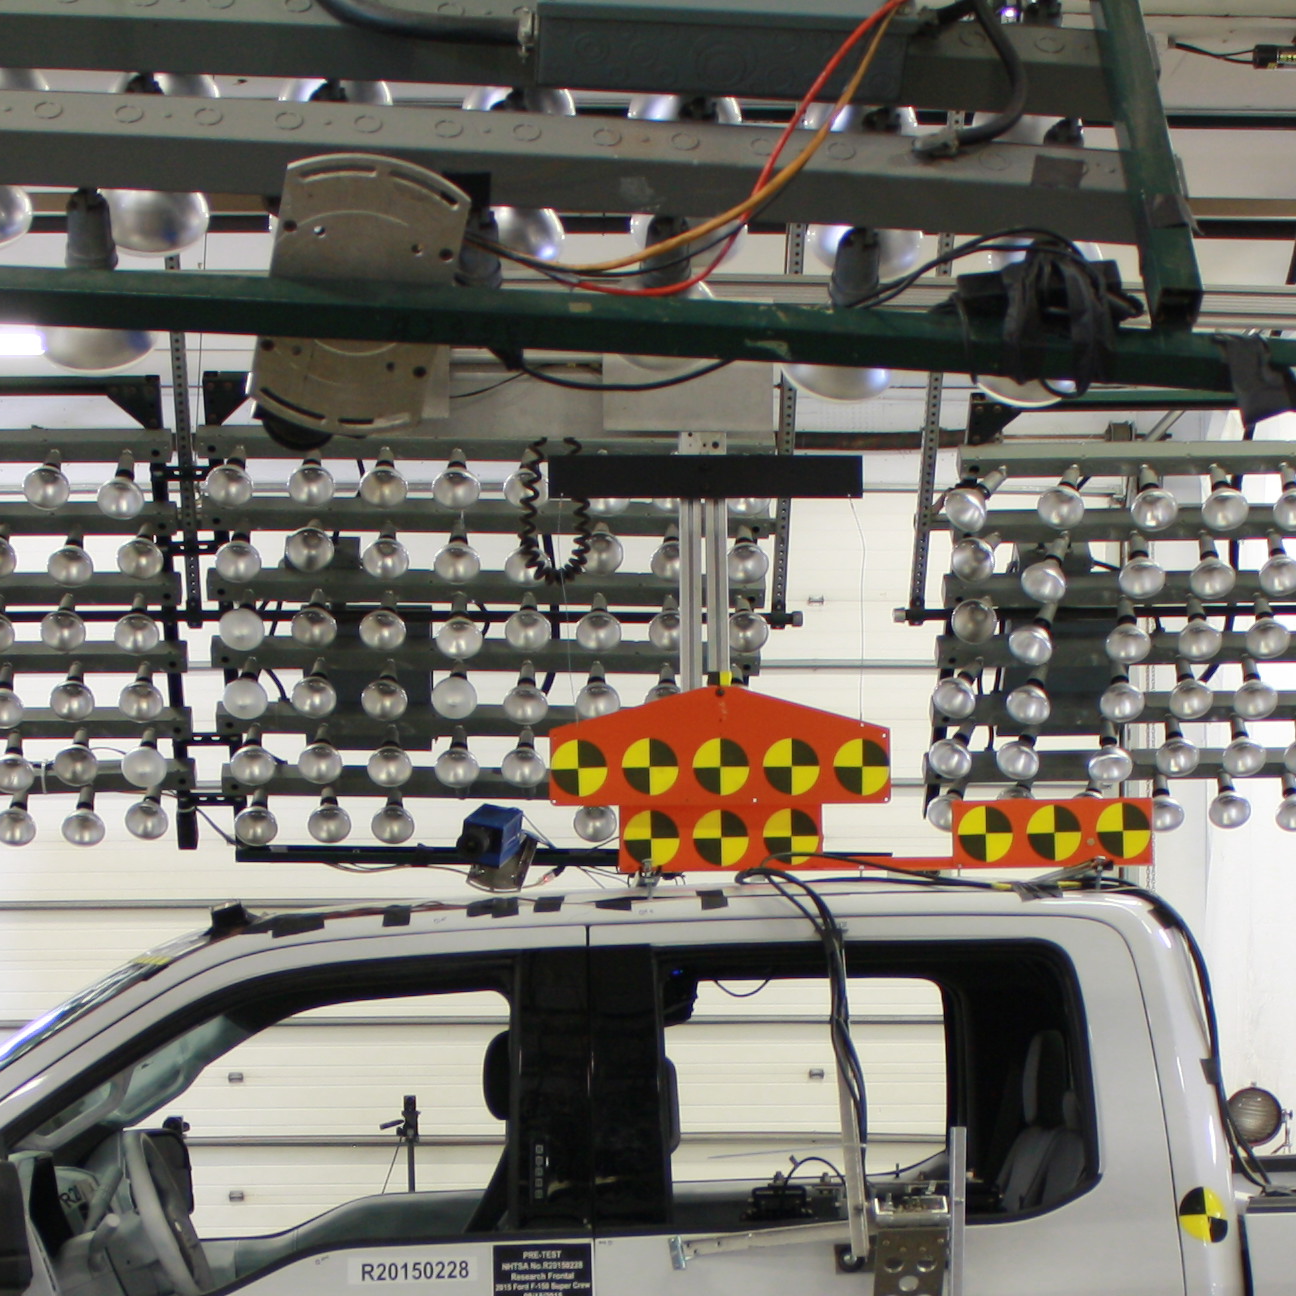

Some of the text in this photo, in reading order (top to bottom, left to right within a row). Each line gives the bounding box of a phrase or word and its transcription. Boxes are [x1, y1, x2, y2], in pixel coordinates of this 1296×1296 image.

[523, 1250, 562, 1260] PRE-TEST
[360, 1260, 469, 1282] R20150228
[501, 1262, 529, 1271] NHTSA
[510, 1271, 575, 1281] Research Frontal
[512, 1282, 529, 1291] Ford
[572, 1280, 591, 1289] Crew
